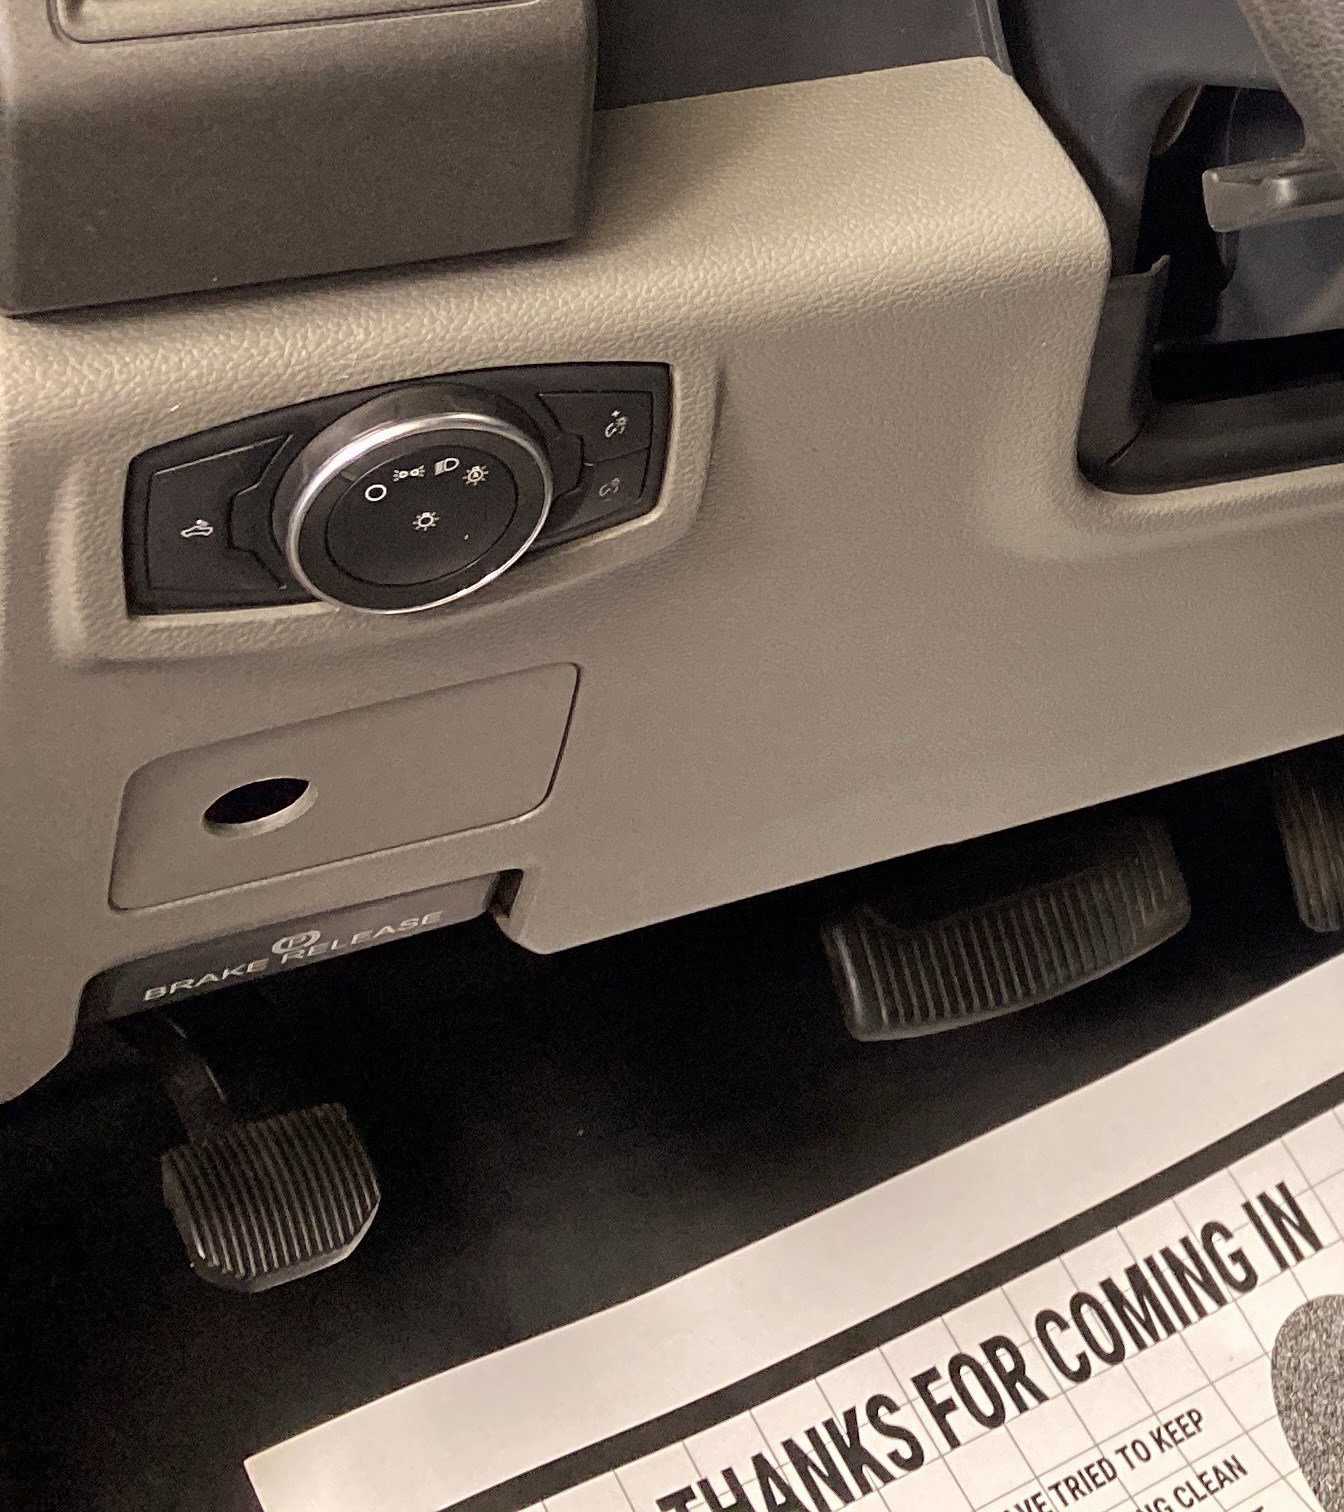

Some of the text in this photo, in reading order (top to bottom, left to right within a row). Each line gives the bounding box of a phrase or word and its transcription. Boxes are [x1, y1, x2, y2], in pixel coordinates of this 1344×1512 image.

[143, 910, 446, 1002] BRAKE RELEASE
[910, 1332, 1051, 1450] FOR
[1034, 1219, 1260, 1384] COMING
[1241, 1180, 1324, 1273] IN
[1047, 1456, 1119, 1508] TRIED
[1114, 1439, 1152, 1473] TO
[1148, 1407, 1205, 1455] KEEP
[1172, 1454, 1249, 1509] CLEAN
